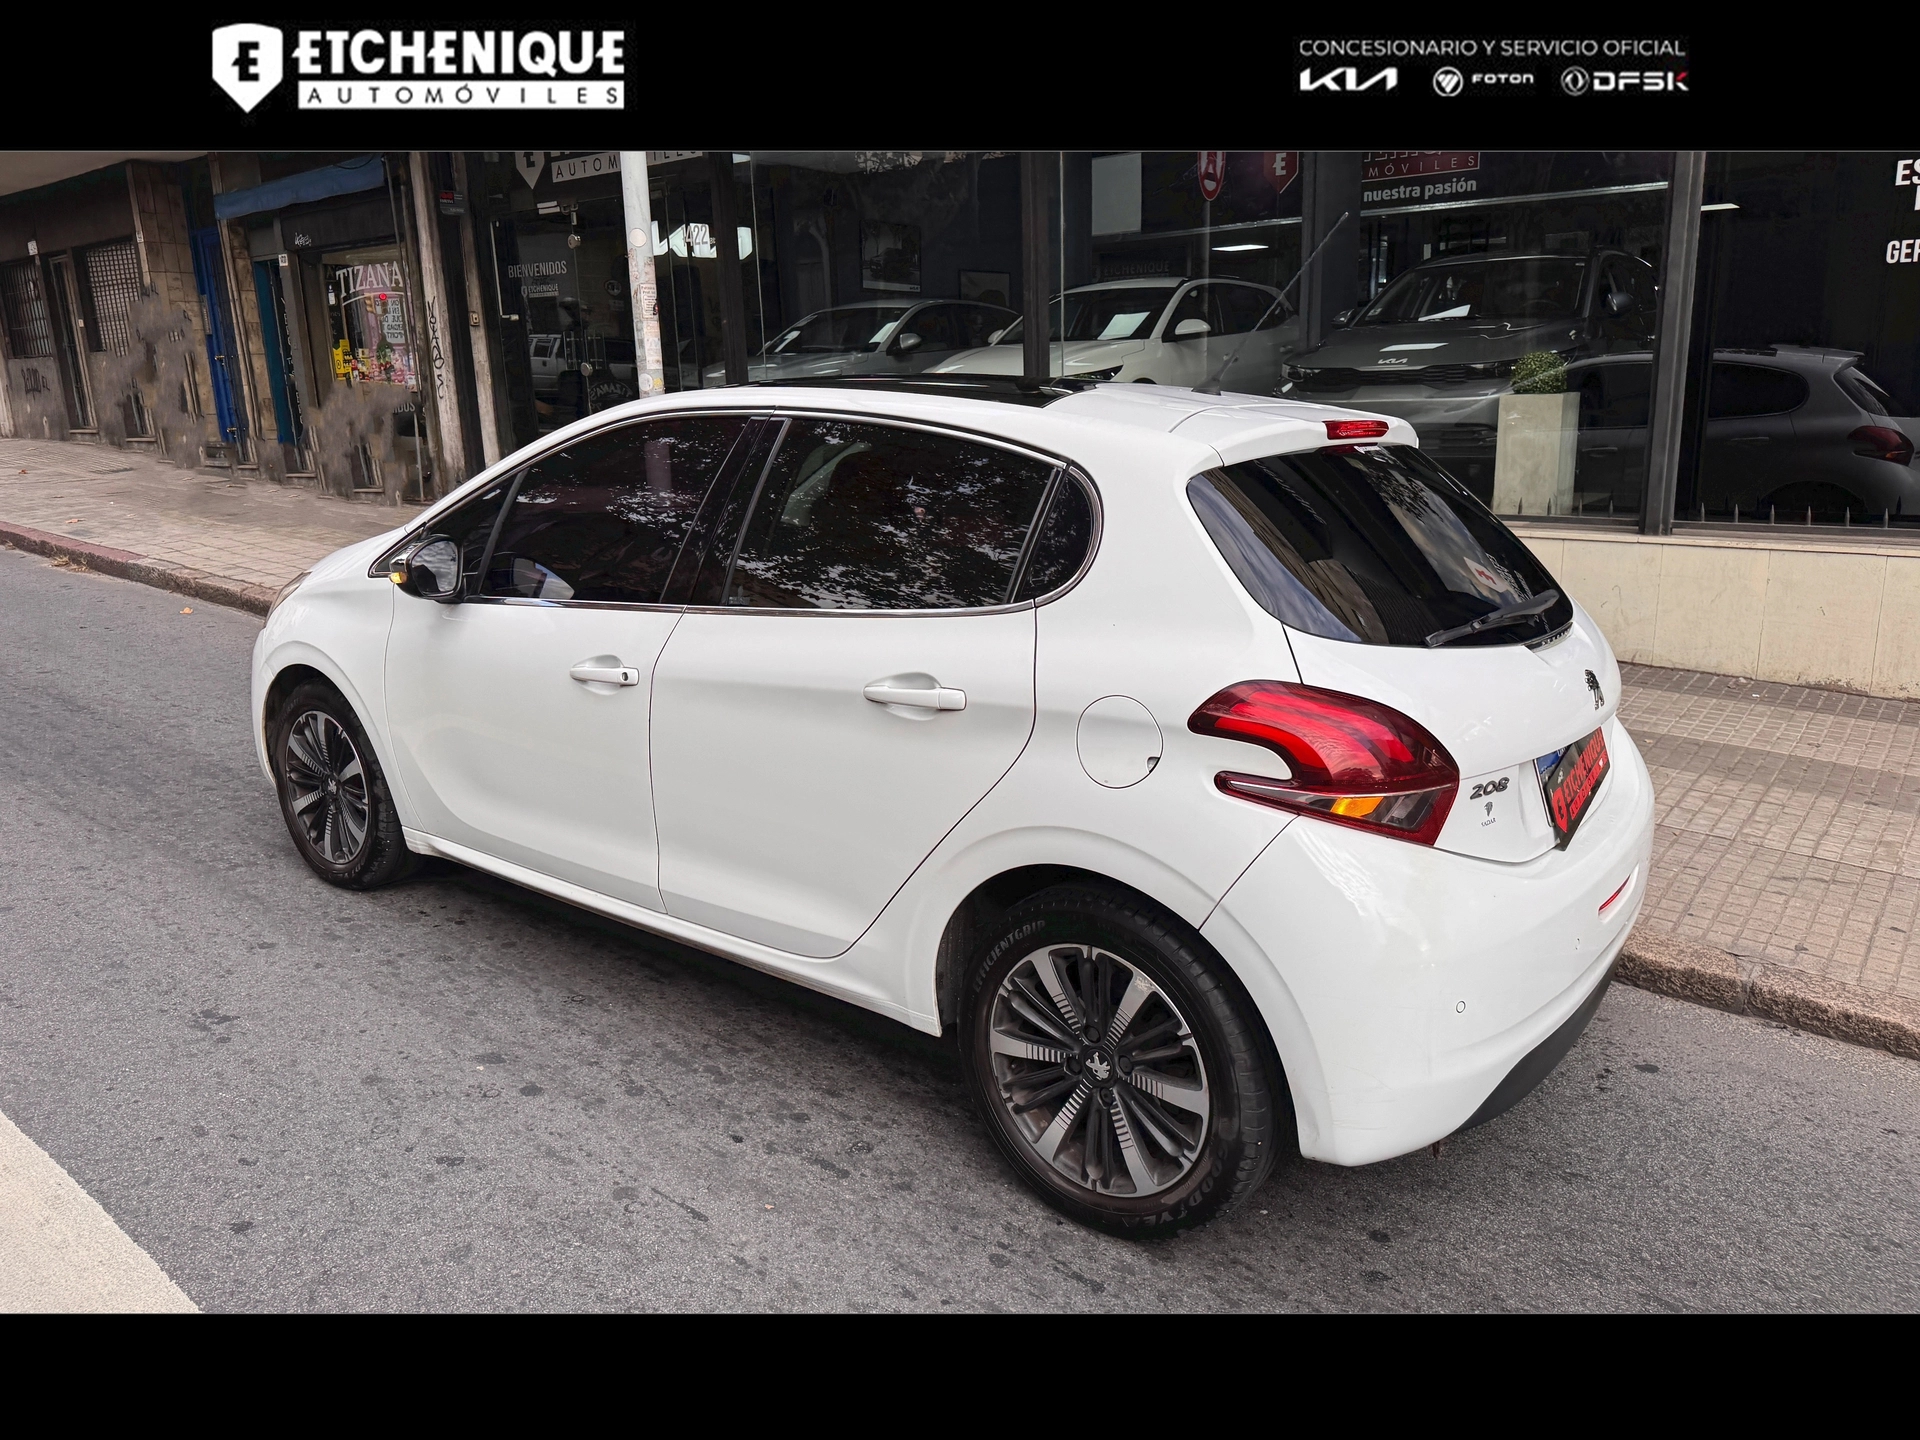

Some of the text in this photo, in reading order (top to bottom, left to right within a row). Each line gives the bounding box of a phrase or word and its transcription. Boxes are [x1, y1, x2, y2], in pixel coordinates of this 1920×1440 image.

[1363, 177, 1477, 202] nuestra pasión
[507, 260, 568, 279] BIENVENIDOS
[1469, 776, 1510, 800] 208
[972, 919, 1047, 993] EFFICIENTGRIP
